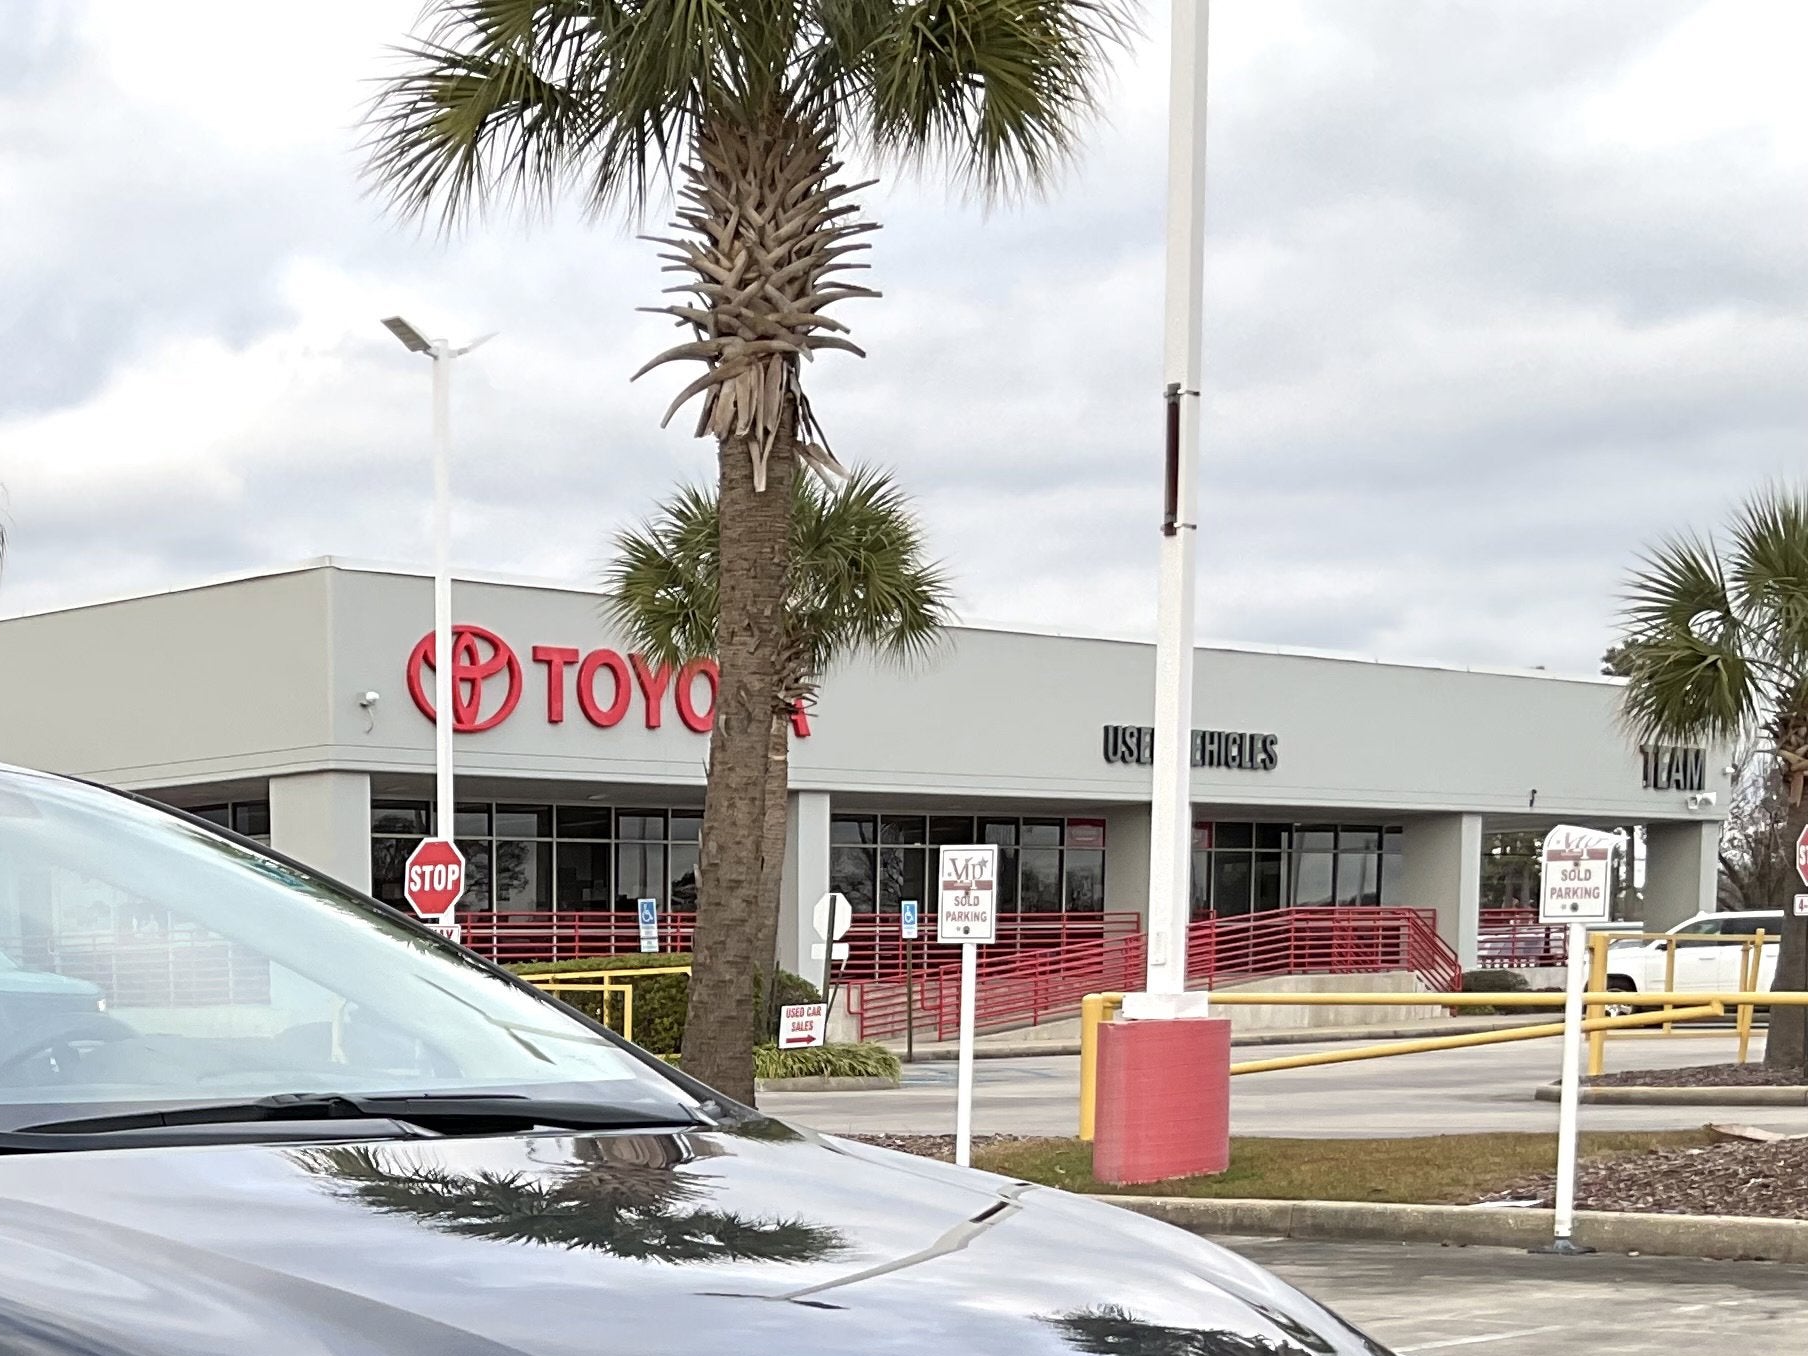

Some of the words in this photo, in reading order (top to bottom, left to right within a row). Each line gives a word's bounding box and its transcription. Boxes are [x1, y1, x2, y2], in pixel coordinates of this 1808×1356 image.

[532, 645, 811, 737] TOYO
[1103, 725, 1155, 764] USE
[1190, 729, 1278, 770] EHICLES
[1640, 745, 1707, 790] TEAM
[409, 864, 460, 892] STOP
[1561, 869, 1592, 881] SOLD
[1550, 887, 1600, 899] PARKING
[954, 895, 980, 906] SOLD
[945, 911, 987, 922] PARKING
[786, 1007, 805, 1018] USED
[807, 1006, 821, 1017] CAR
[792, 1020, 814, 1032] SALES
